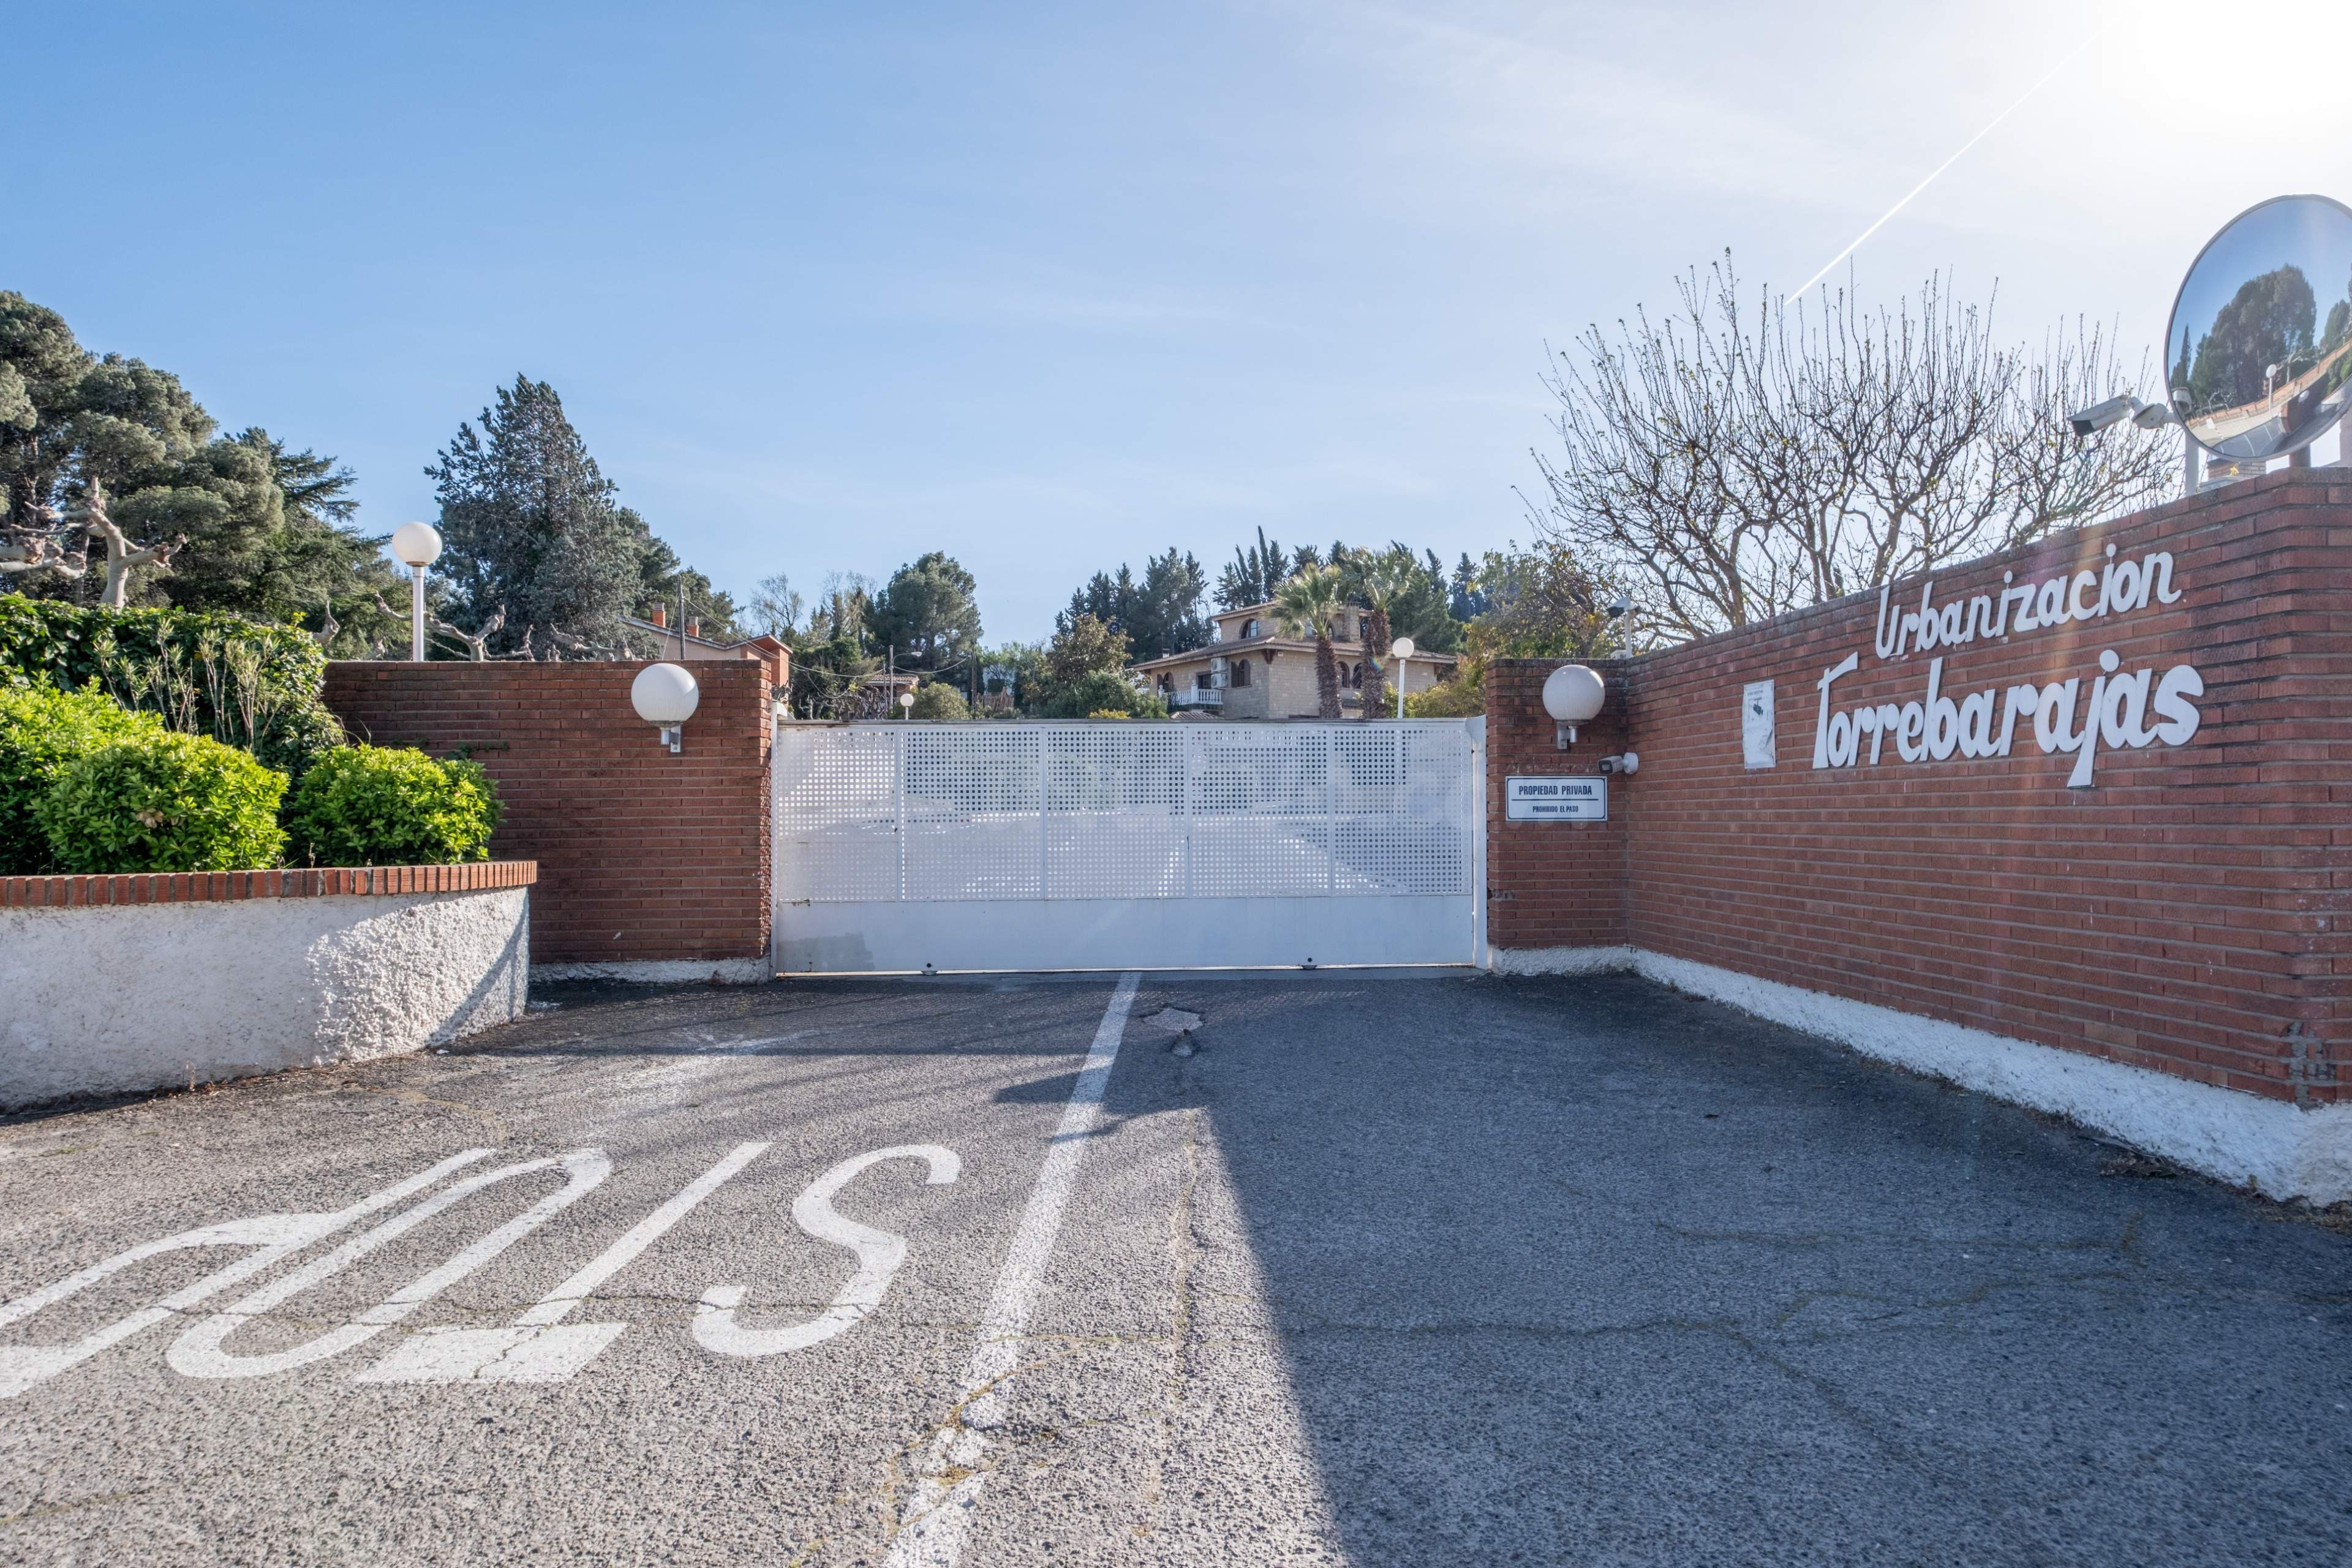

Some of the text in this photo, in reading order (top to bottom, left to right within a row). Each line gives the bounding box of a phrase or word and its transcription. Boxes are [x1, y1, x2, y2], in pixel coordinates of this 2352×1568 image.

[1875, 543, 2182, 660] Urbanizacion
[1812, 649, 2204, 788] Torrebarajas
[1518, 785, 1593, 796] PROPIEDAD PRIVADA
[0, 1142, 960, 1398] STOP
